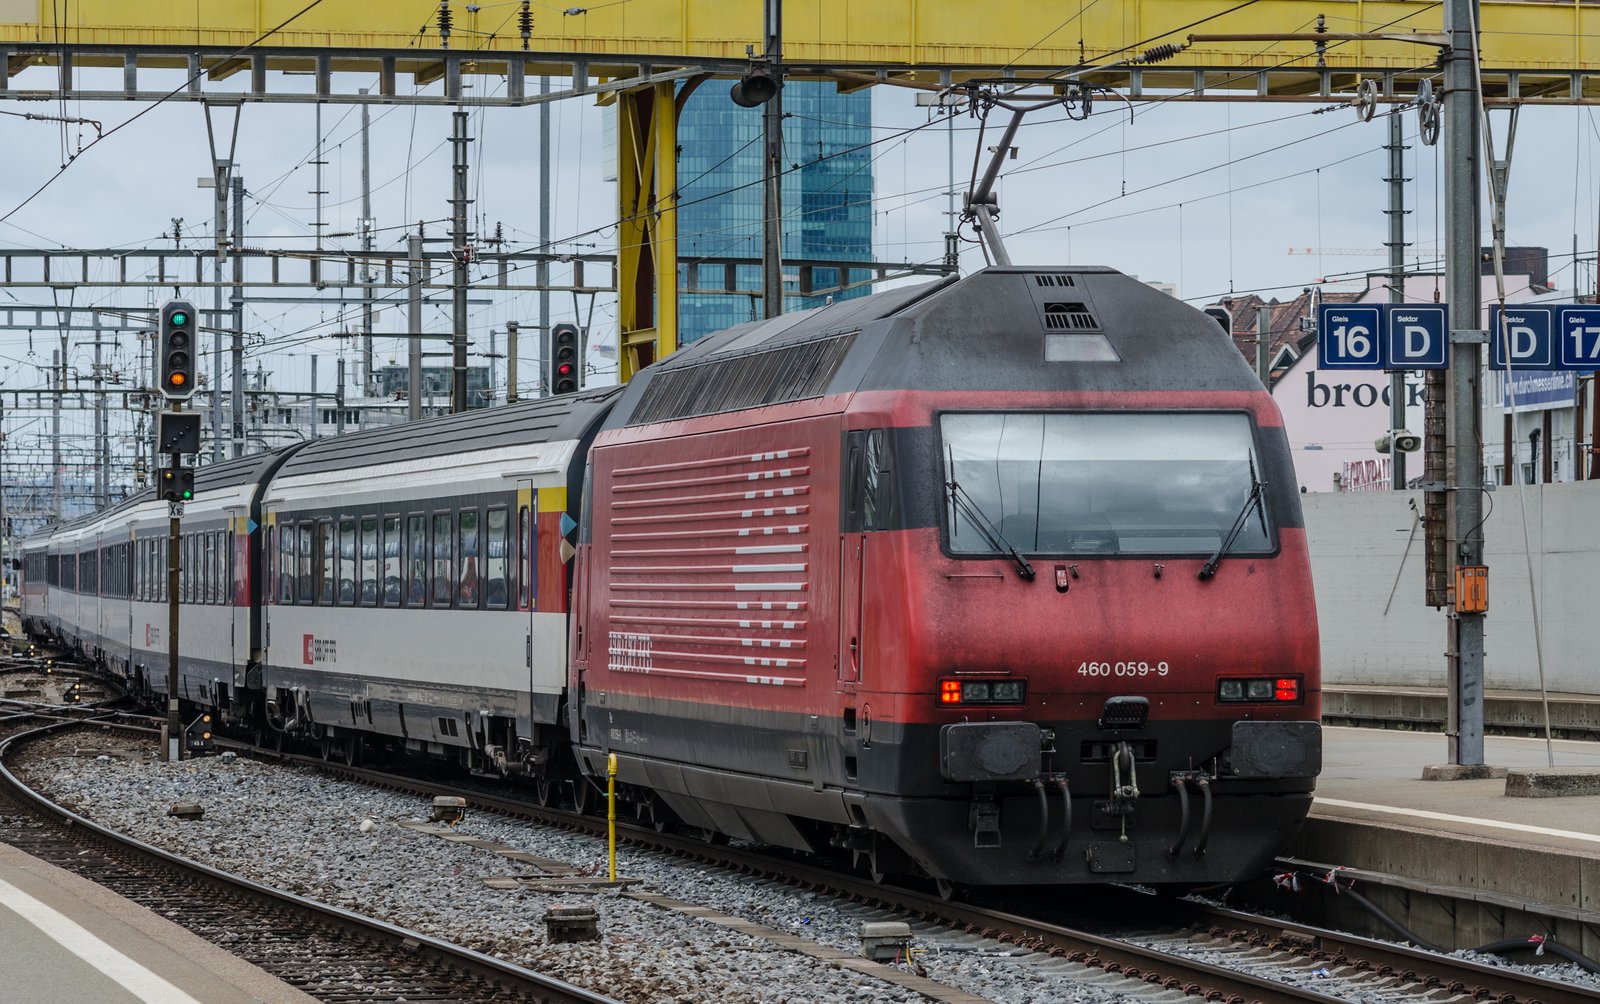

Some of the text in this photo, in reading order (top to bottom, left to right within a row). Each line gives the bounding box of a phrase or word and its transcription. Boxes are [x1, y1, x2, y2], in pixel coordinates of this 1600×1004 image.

[1333, 325, 1371, 358] 16
[1404, 325, 1431, 358] D
[1511, 326, 1537, 358] D
[1570, 326, 1600, 359] 17
[1505, 371, 1573, 396] ww.durchmesserlinie.ch
[1077, 661, 1169, 677] 460 059-9
